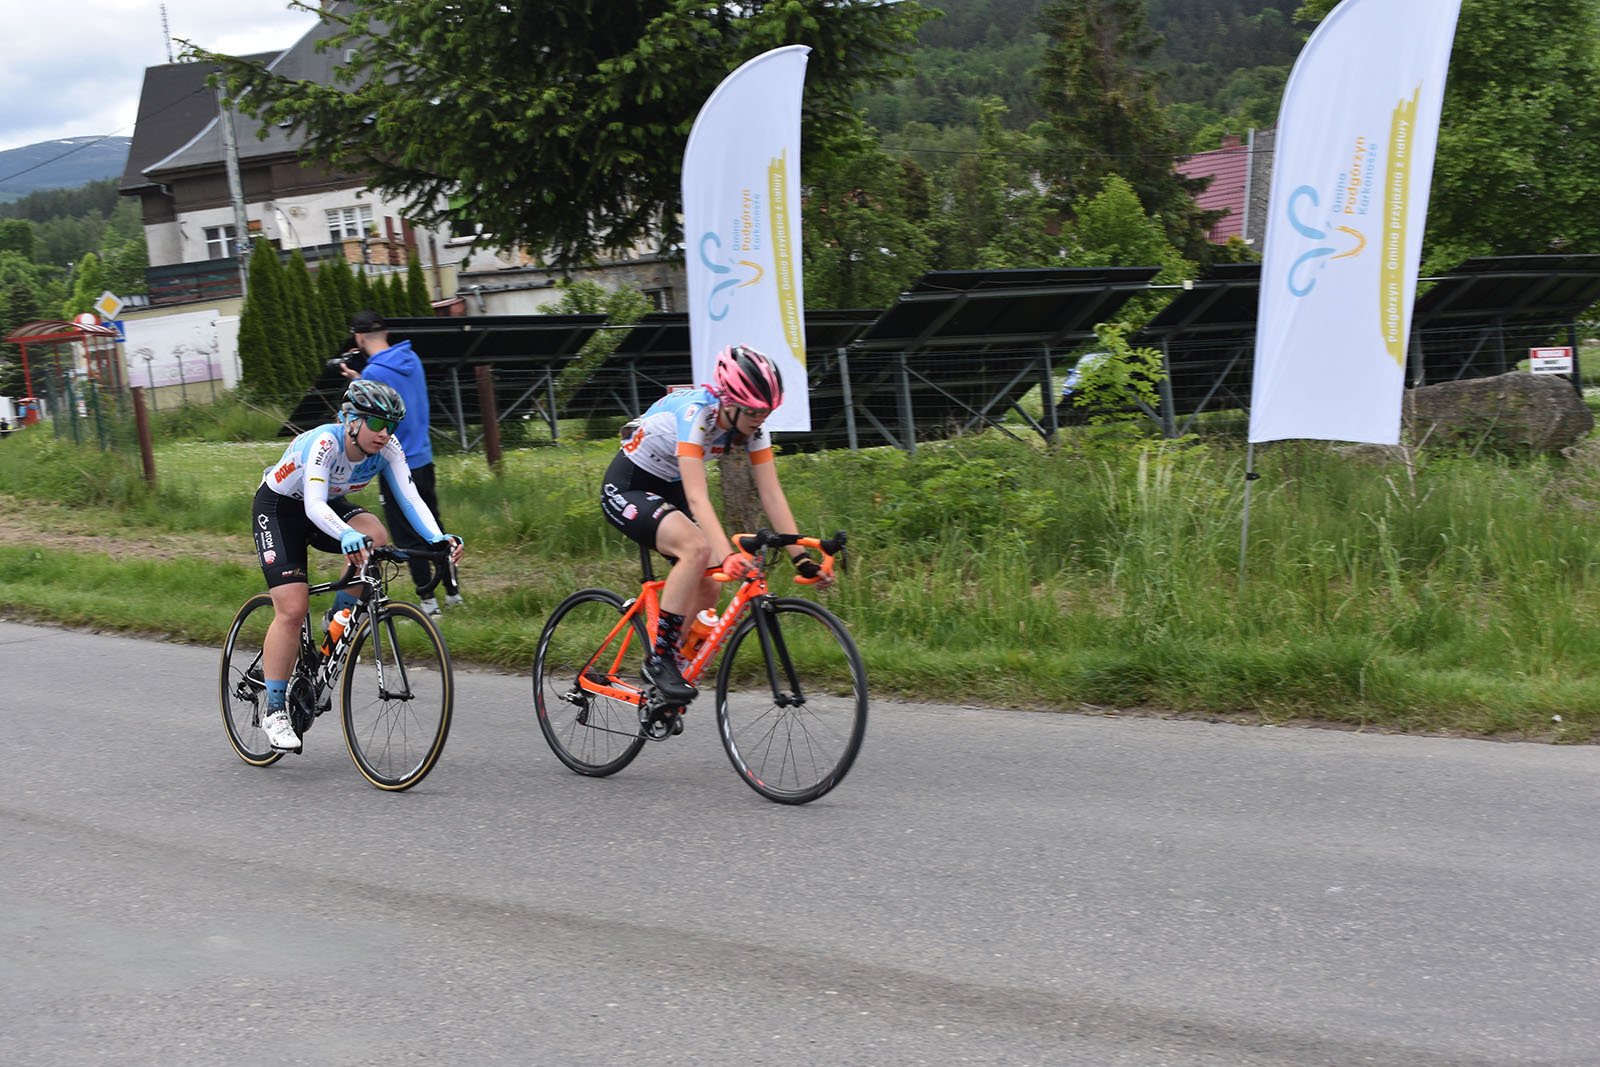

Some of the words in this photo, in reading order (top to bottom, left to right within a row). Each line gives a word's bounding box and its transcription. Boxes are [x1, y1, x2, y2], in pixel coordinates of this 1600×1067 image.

[1395, 120, 1408, 158] natury
[1344, 136, 1367, 215] Podgórzyn
[1358, 143, 1378, 215] Karkonosze
[1391, 172, 1404, 229] przyjazna
[741, 189, 753, 252] Podgórzyn
[1387, 232, 1399, 271] Gmina
[1386, 282, 1399, 343] Podgórzyn
[264, 530, 274, 549] ATOM
